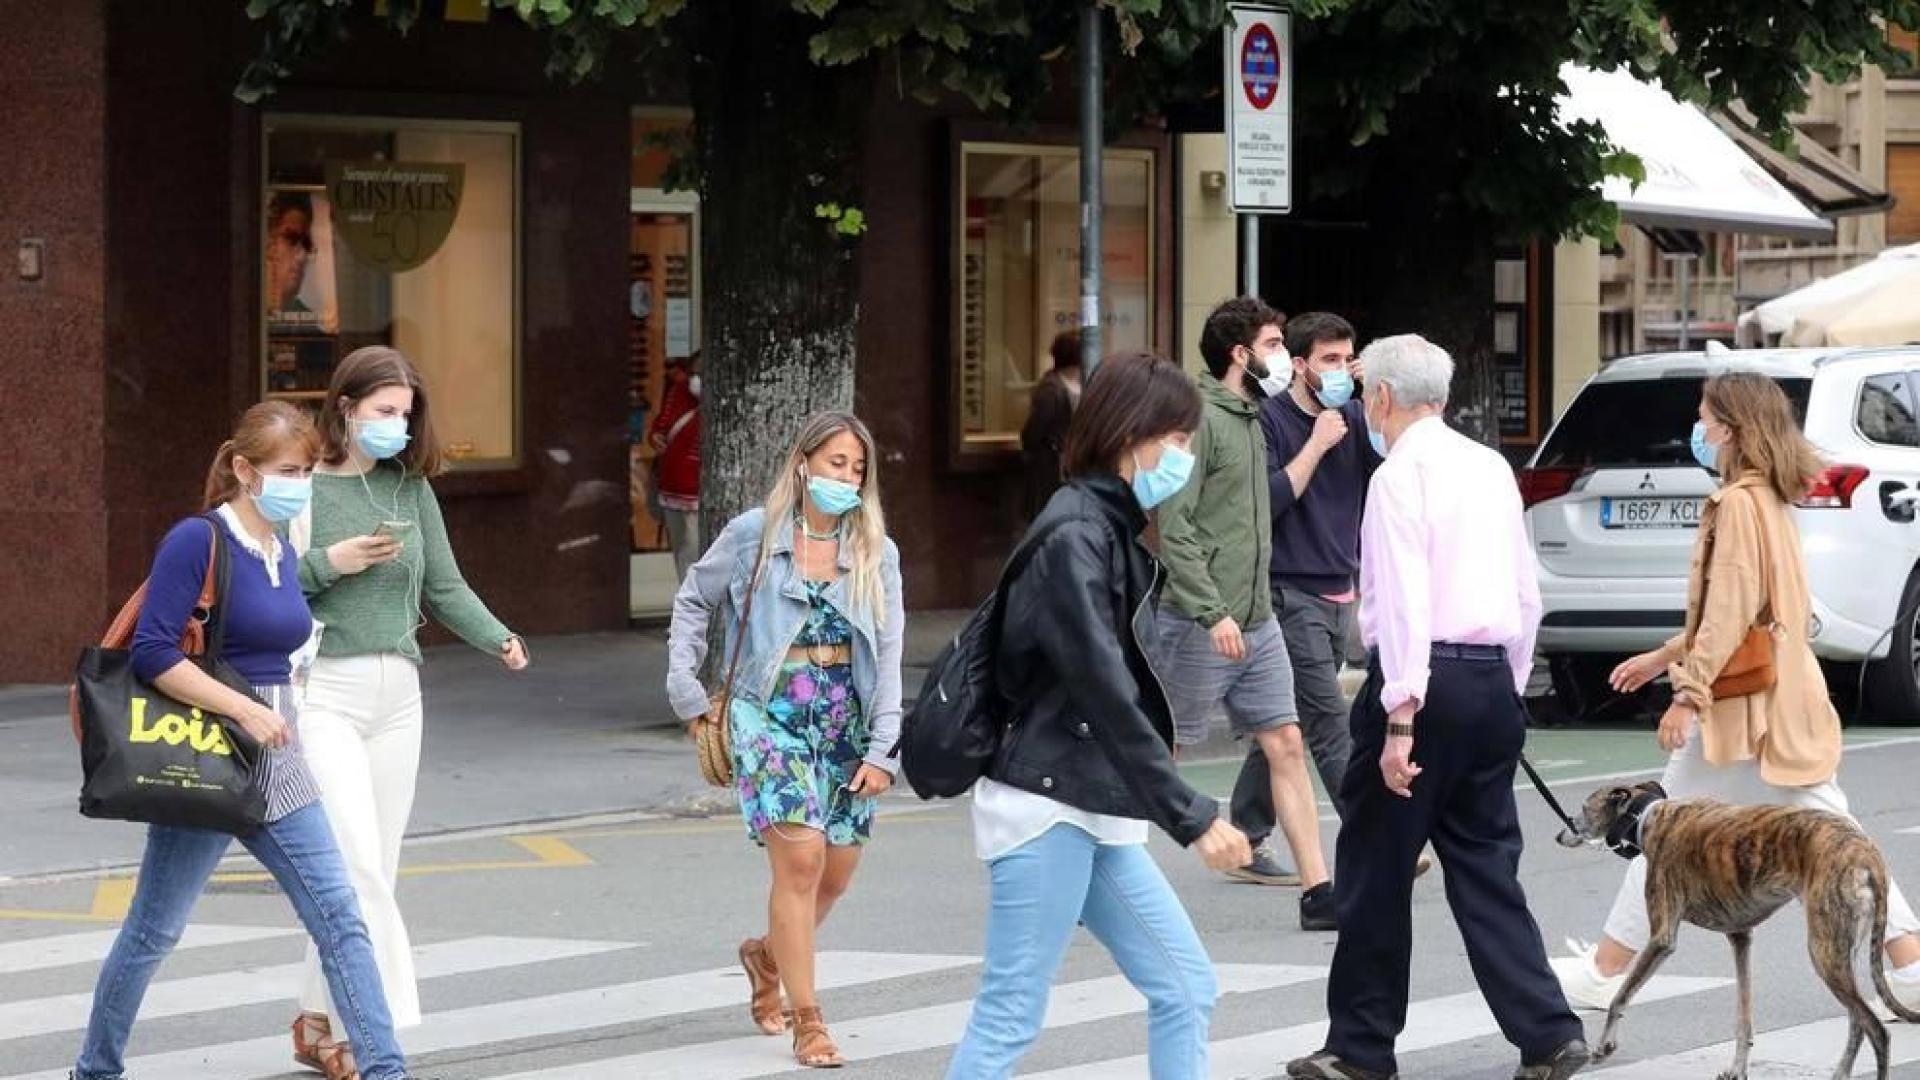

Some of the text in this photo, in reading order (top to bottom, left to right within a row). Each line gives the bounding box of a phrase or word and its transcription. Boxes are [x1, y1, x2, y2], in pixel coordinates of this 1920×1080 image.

[334, 181, 457, 210] CRISTALES
[1618, 502, 1661, 521] 1667
[130, 697, 231, 755] Lois
